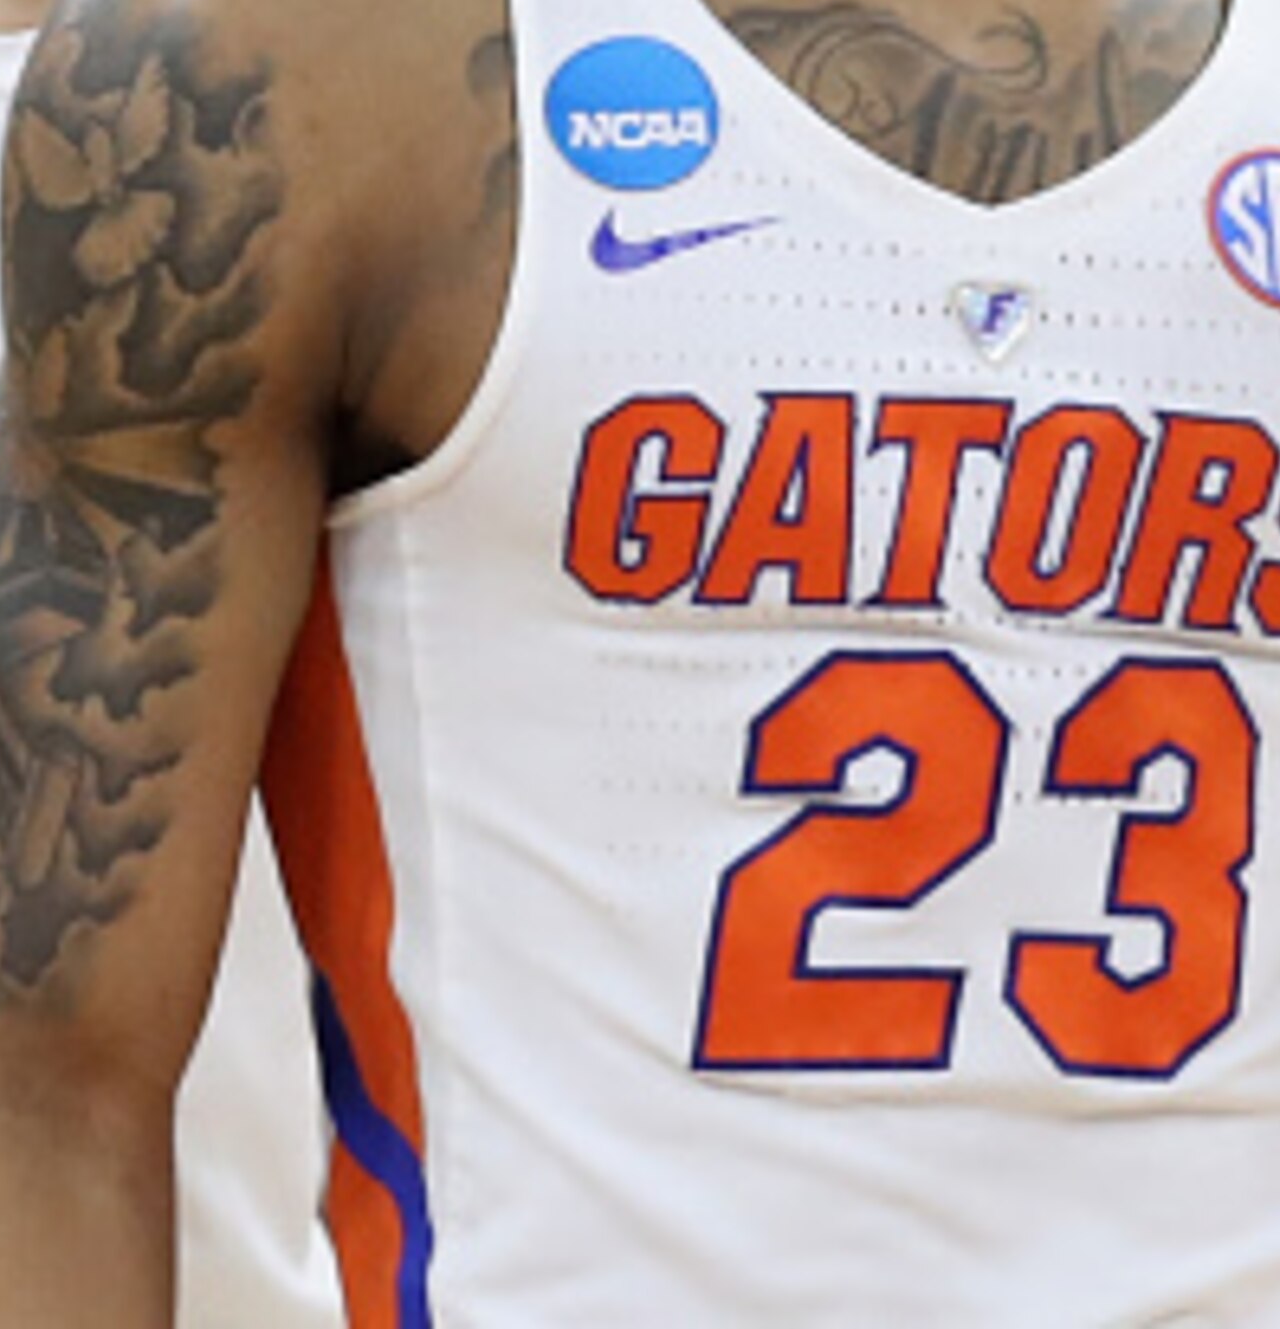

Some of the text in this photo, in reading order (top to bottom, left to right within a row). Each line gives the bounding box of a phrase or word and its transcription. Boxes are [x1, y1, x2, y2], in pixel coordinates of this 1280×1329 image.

[568, 108, 708, 149] NCAA
[981, 291, 1017, 334] F
[691, 649, 1260, 1080] 23
